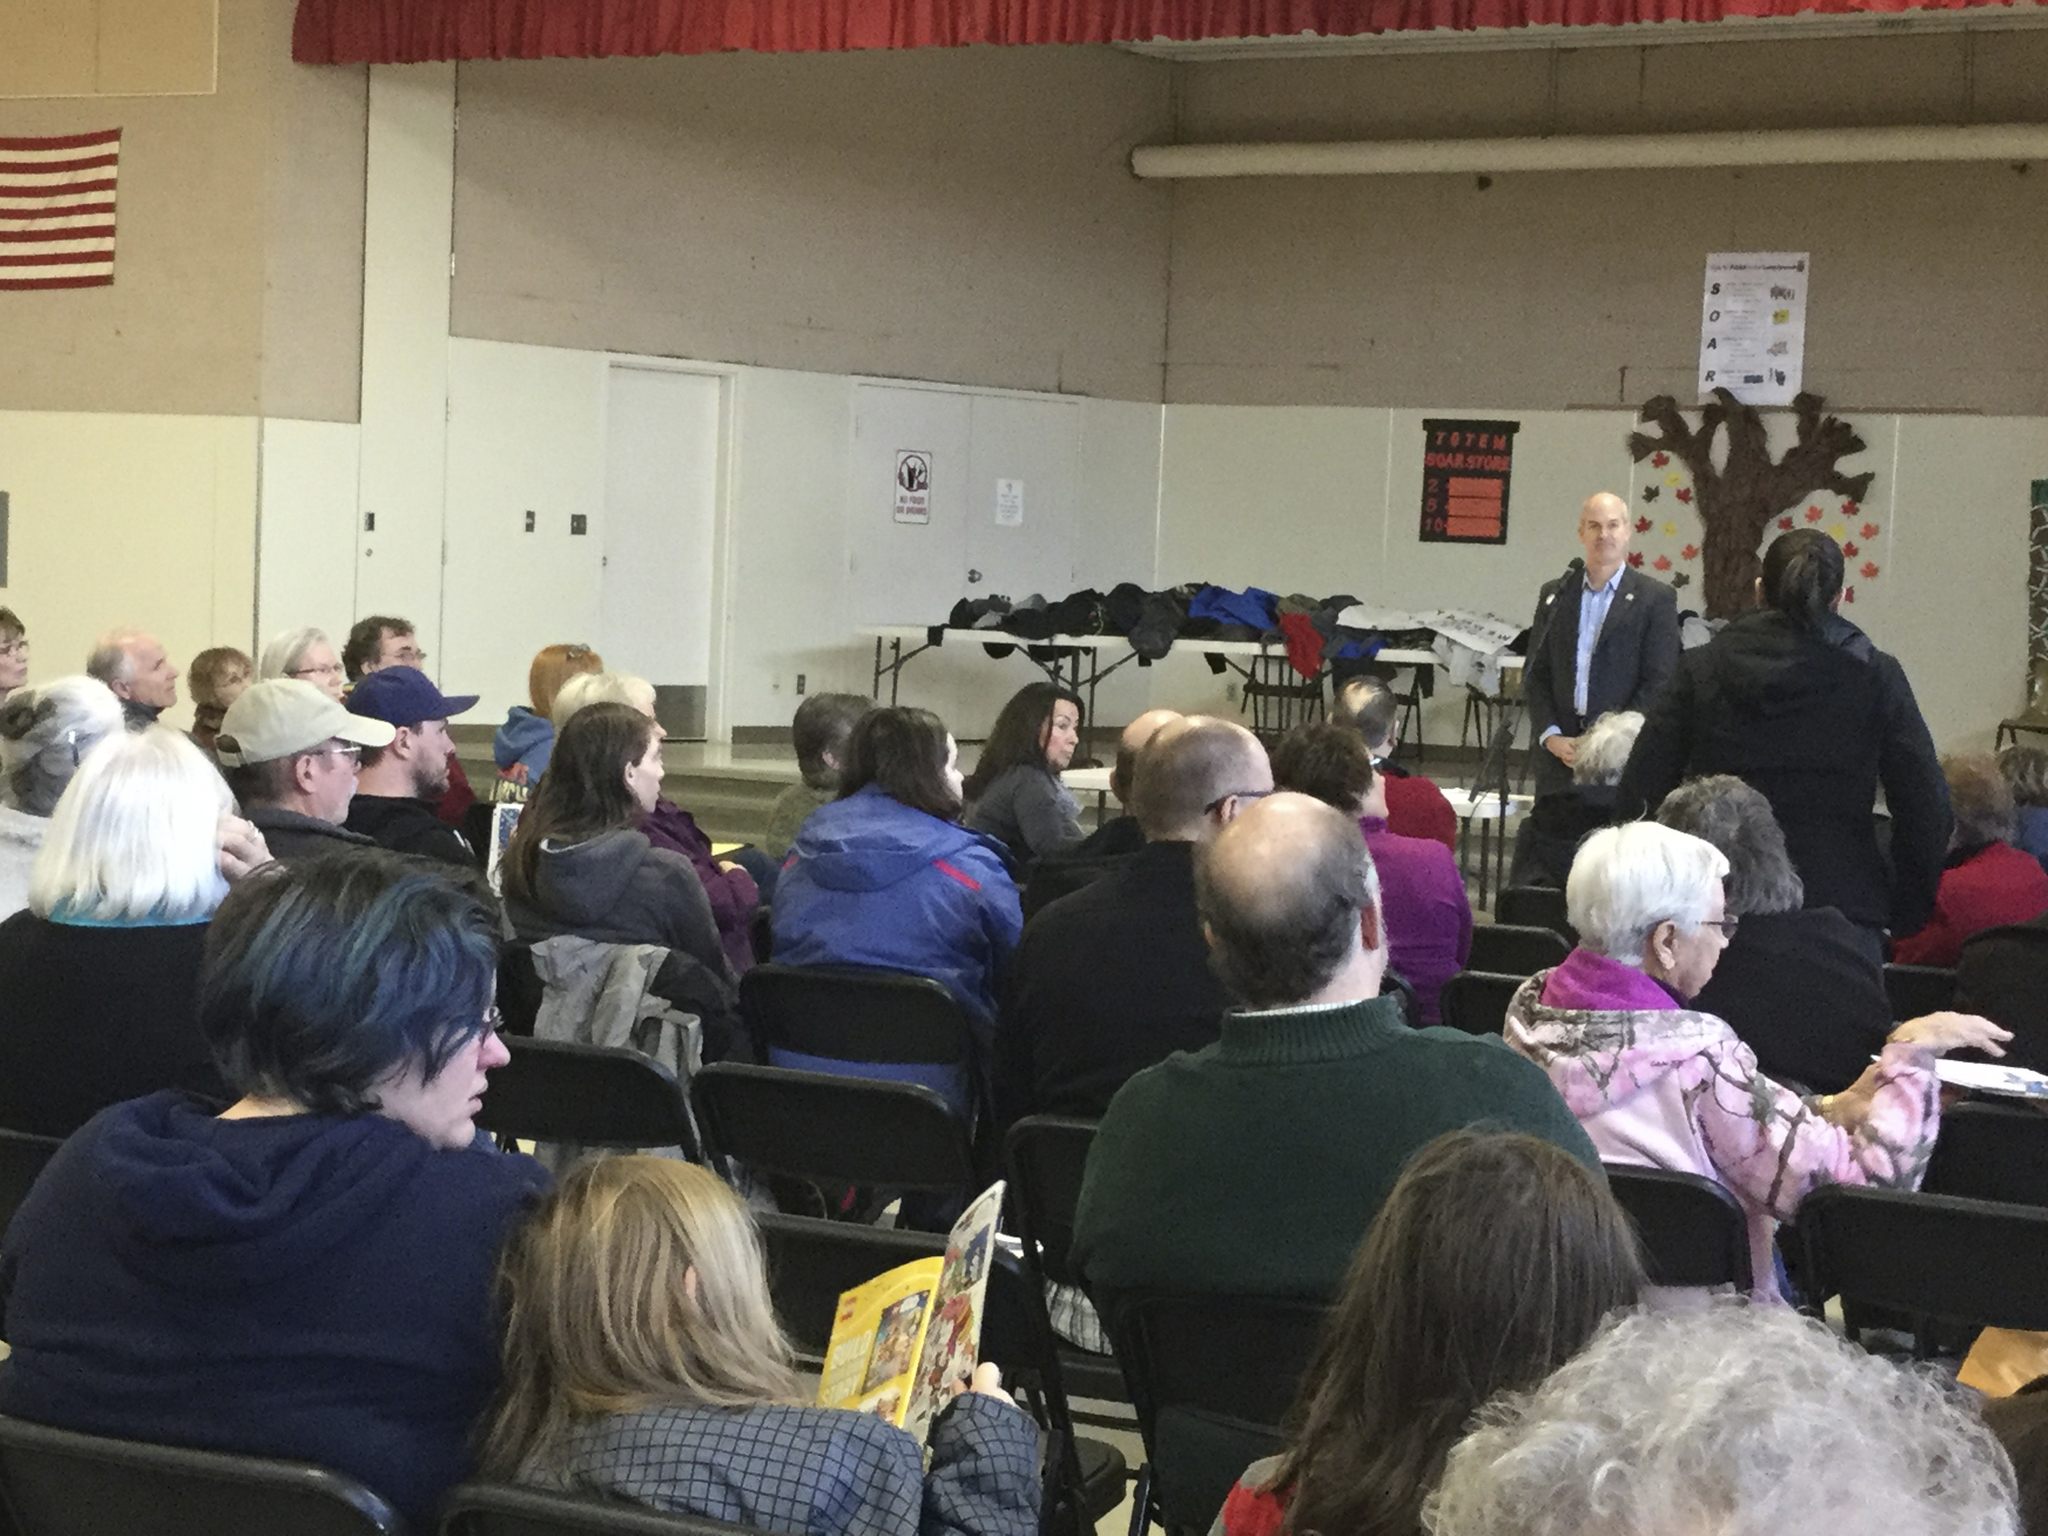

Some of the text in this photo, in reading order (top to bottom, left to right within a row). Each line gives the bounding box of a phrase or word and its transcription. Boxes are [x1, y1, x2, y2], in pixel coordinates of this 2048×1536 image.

[1710, 282, 1721, 295] S
[1709, 310, 1720, 322] O
[1706, 338, 1717, 350] A
[1705, 370, 1716, 382] R
[1436, 431, 1506, 450] TOTEM
[1428, 478, 1439, 493] 2
